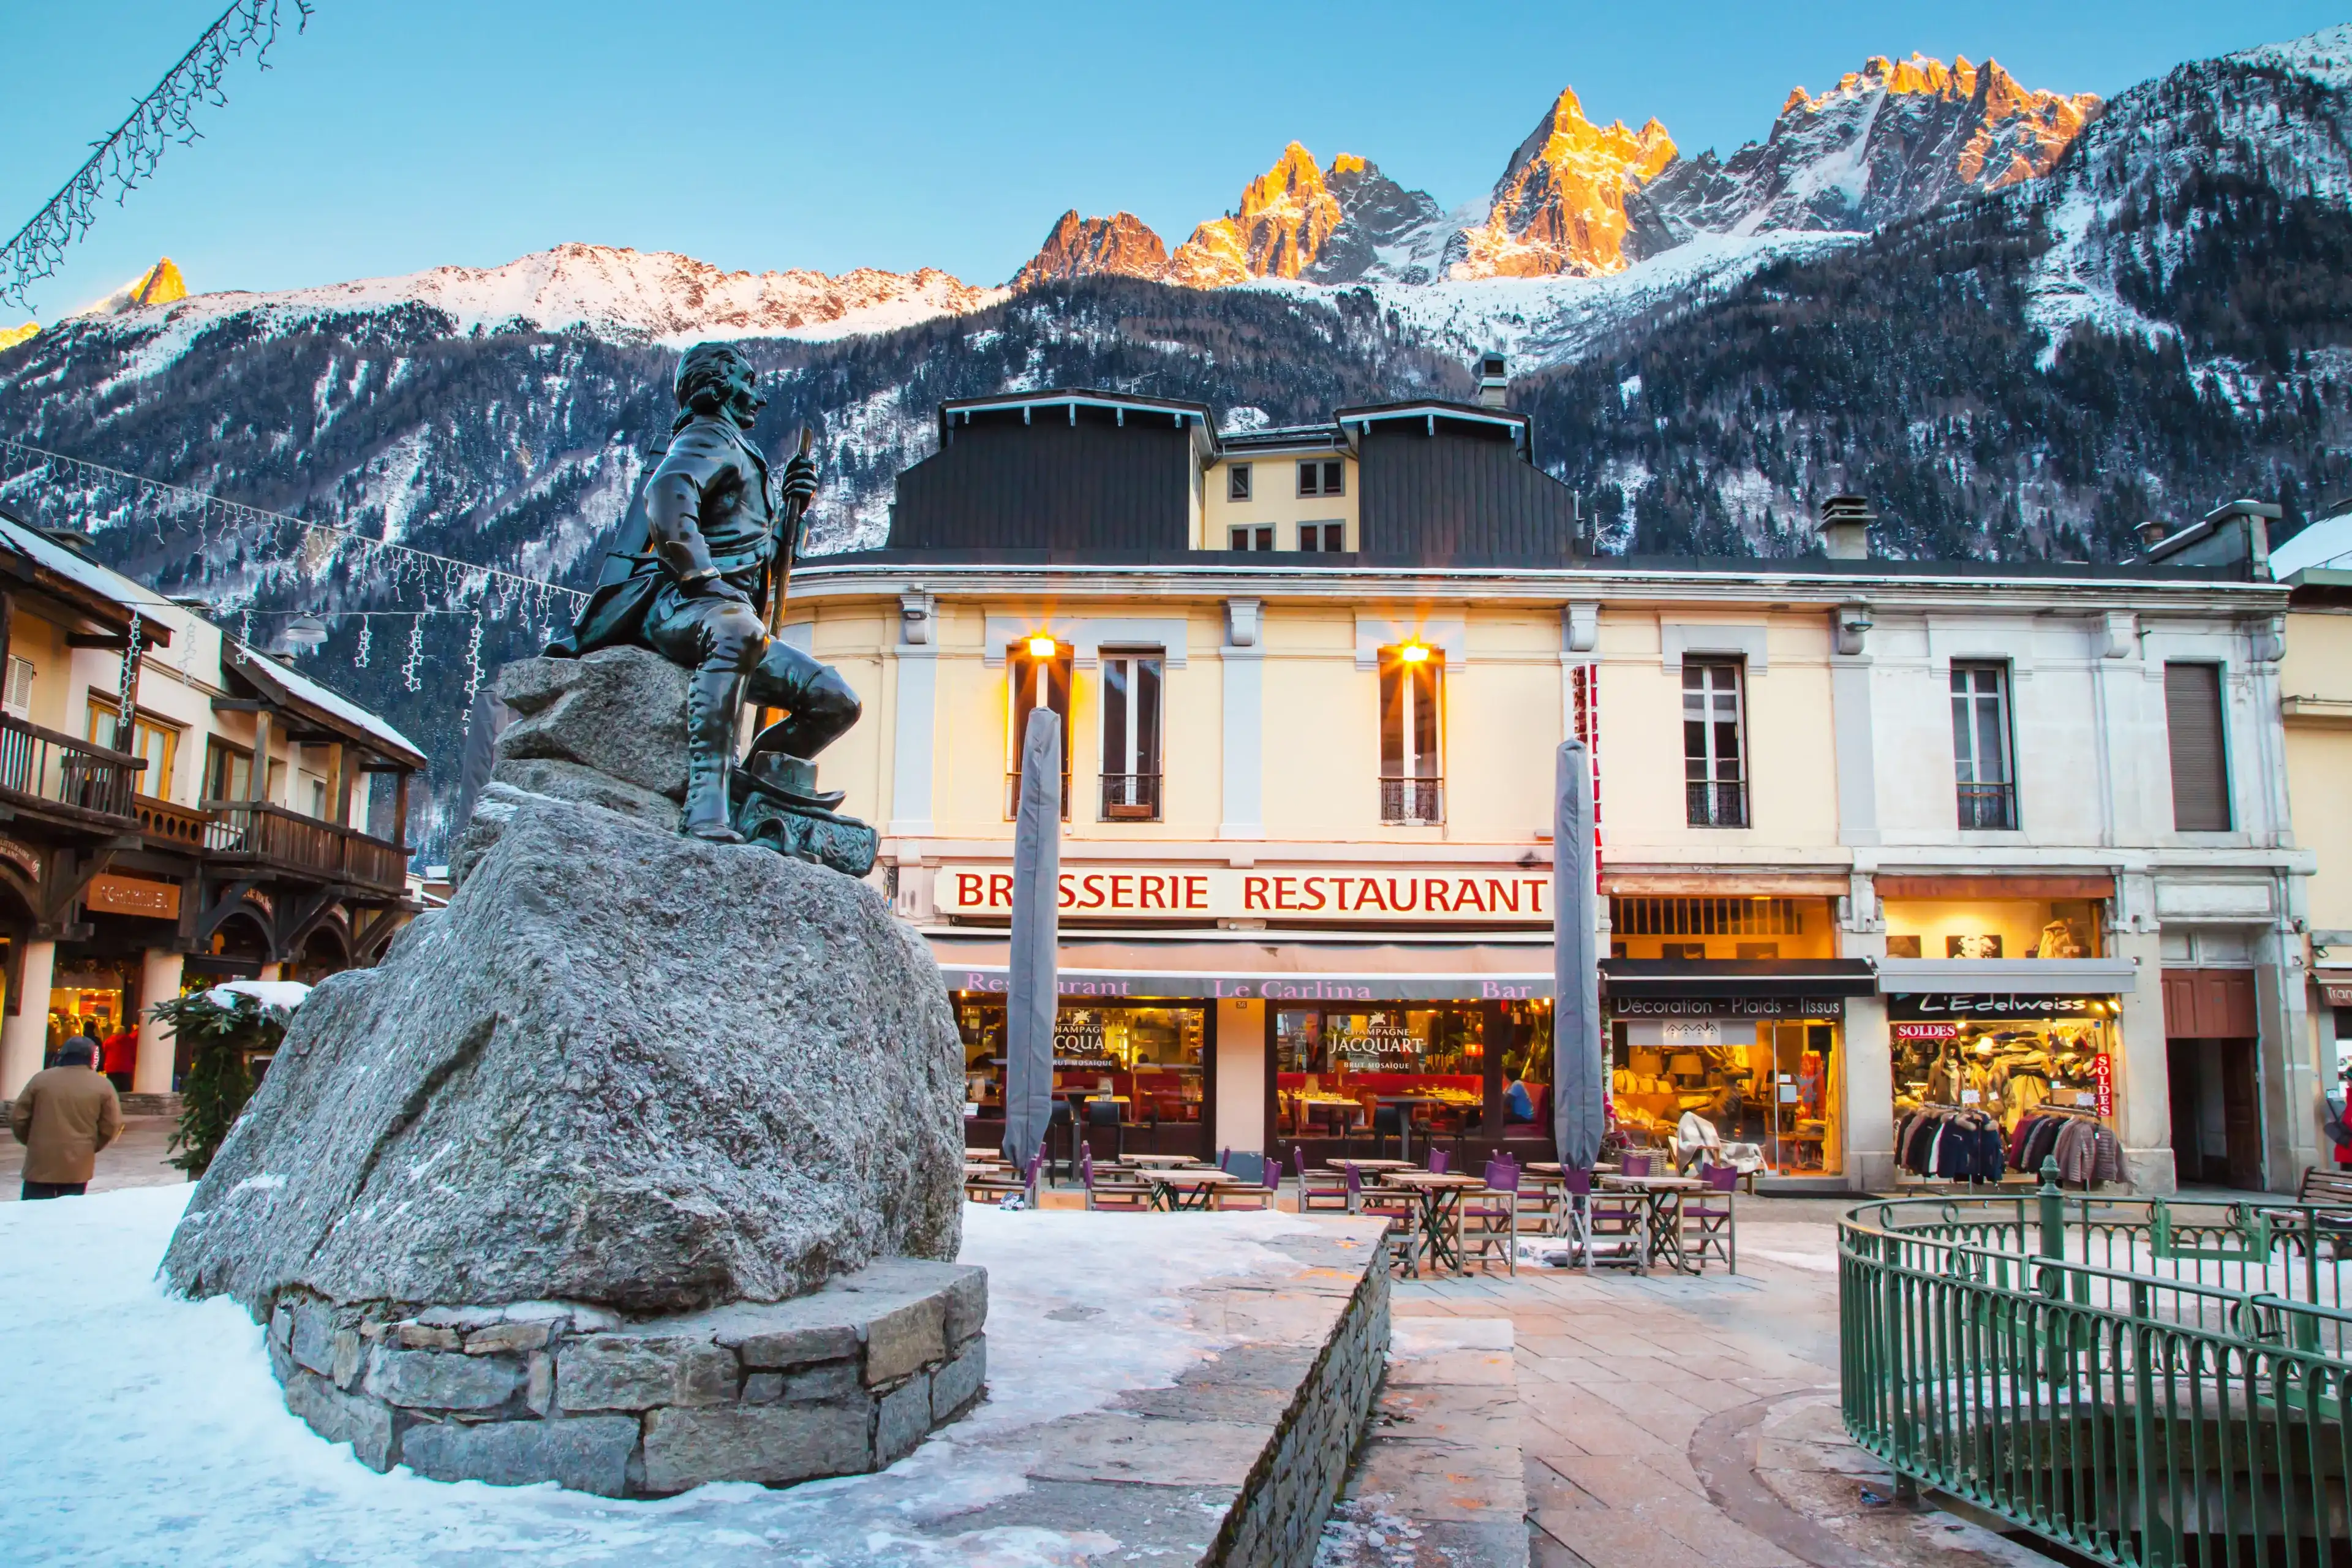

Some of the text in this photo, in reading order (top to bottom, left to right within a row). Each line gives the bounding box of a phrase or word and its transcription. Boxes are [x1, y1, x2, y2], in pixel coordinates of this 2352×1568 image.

[956, 873, 1548, 912] BRSSERIE RESTAURANT
[967, 973, 1532, 999] Rerant Le Carlina Bar
[1618, 997, 1712, 1013] Décoration
[1732, 997, 1781, 1013] Plaids
[1919, 993, 2087, 1012] L'Edelweiss
[1344, 1028, 1411, 1036] CHAMPAGNE
[1899, 1025, 1956, 1037] SOLDES
[1329, 1033, 1424, 1055] JACQUART
[2097, 1055, 2110, 1115] SOLDES
